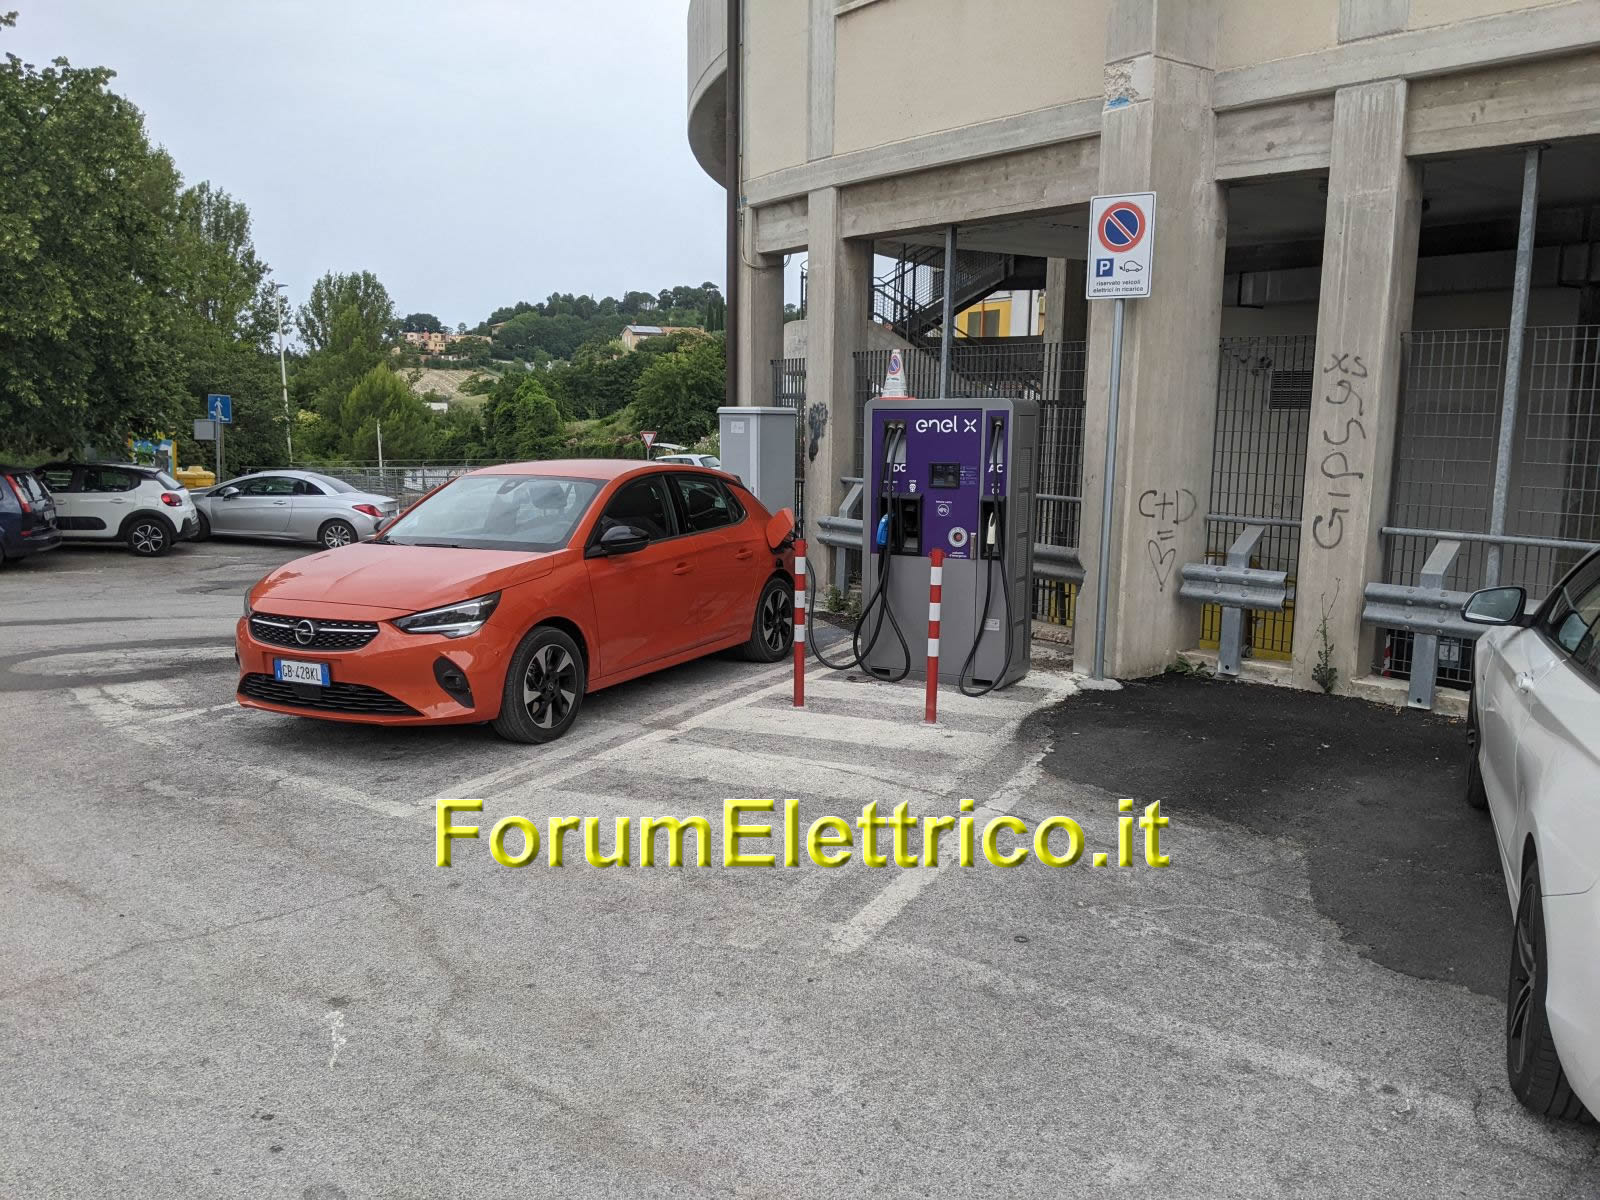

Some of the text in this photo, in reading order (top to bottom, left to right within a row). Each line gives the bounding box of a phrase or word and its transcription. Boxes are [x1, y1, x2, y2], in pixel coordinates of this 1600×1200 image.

[1099, 261, 1110, 275] P
[915, 415, 958, 433] enel
[892, 463, 907, 473] DC
[988, 463, 1004, 473] AC
